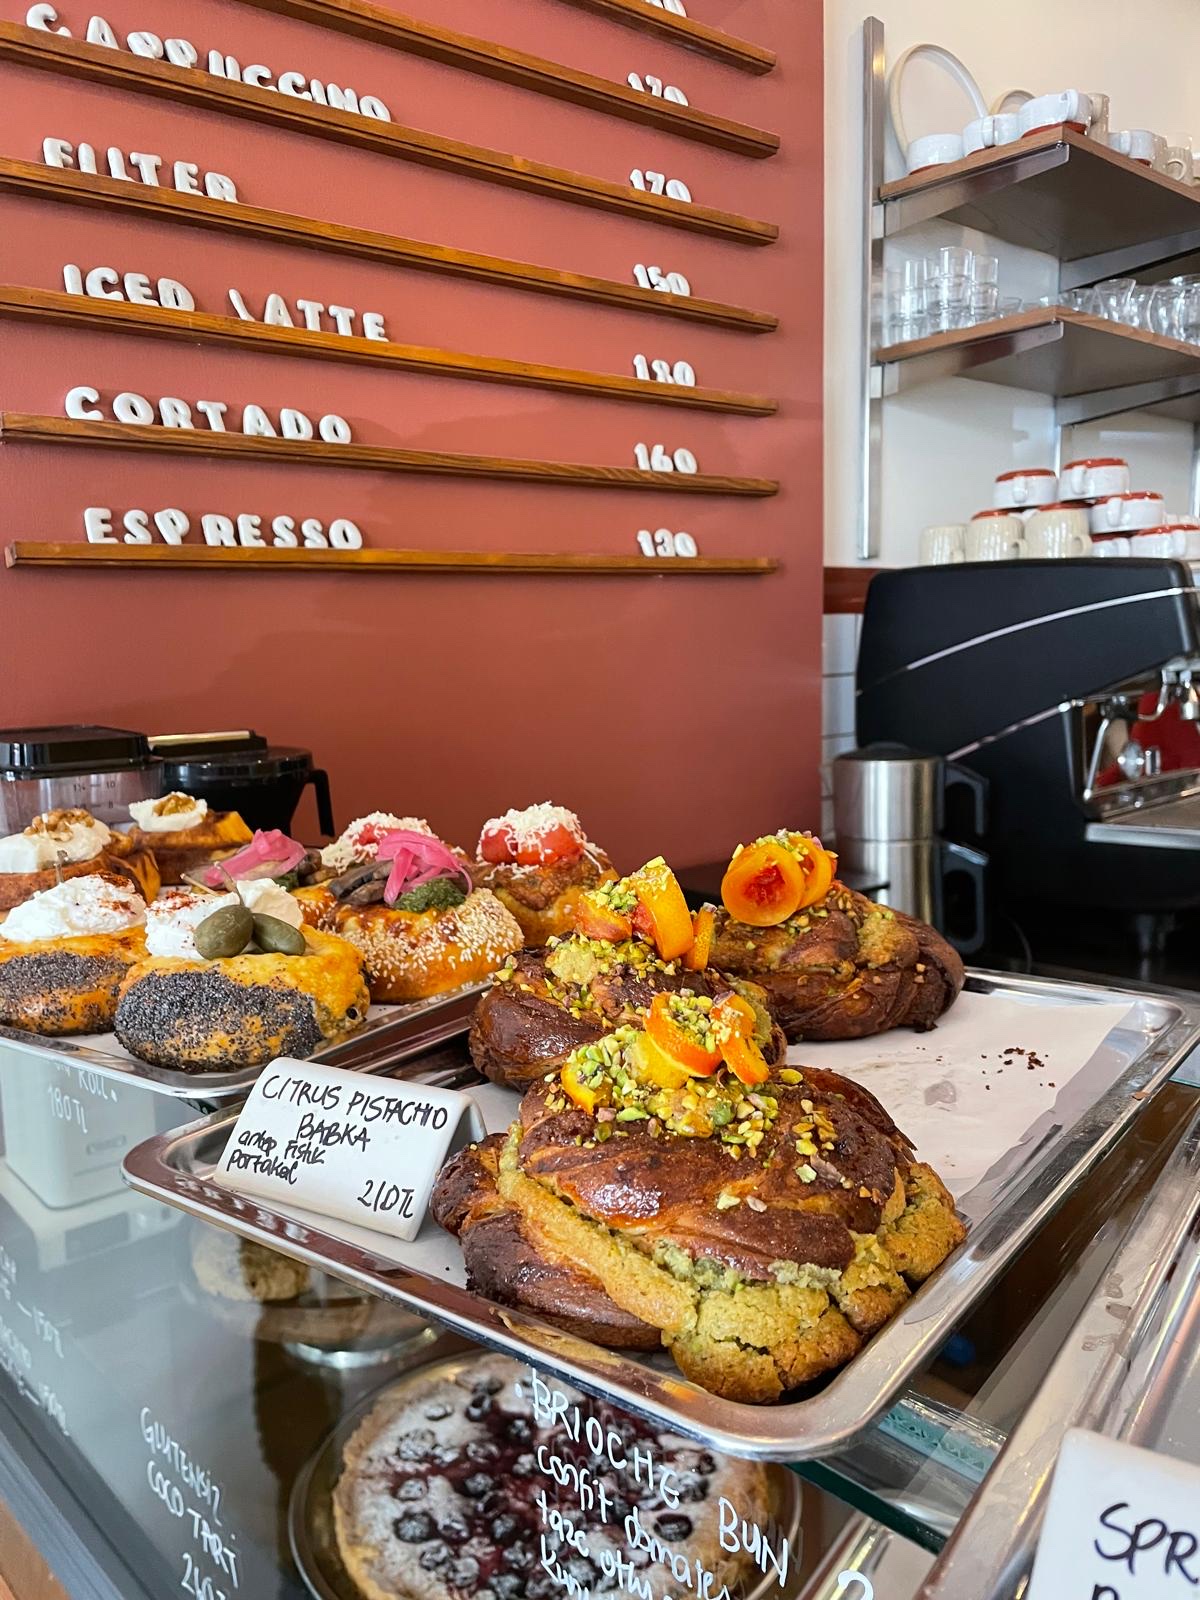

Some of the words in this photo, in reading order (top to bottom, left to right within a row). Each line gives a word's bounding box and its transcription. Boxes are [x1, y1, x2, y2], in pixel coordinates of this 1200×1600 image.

[42, 137, 239, 203] FILTER
[633, 264, 690, 297] 150
[63, 264, 195, 312] ICED
[228, 289, 389, 342] LATTE
[64, 386, 352, 444] CORTADO
[634, 443, 698, 474] 160
[83, 507, 363, 550] ESPRESSO
[637, 528, 698, 558] 130
[262, 1075, 343, 1110] CITRUS
[296, 1113, 371, 1152] BABKA
[532, 1368, 680, 1509] BRIOCHE
